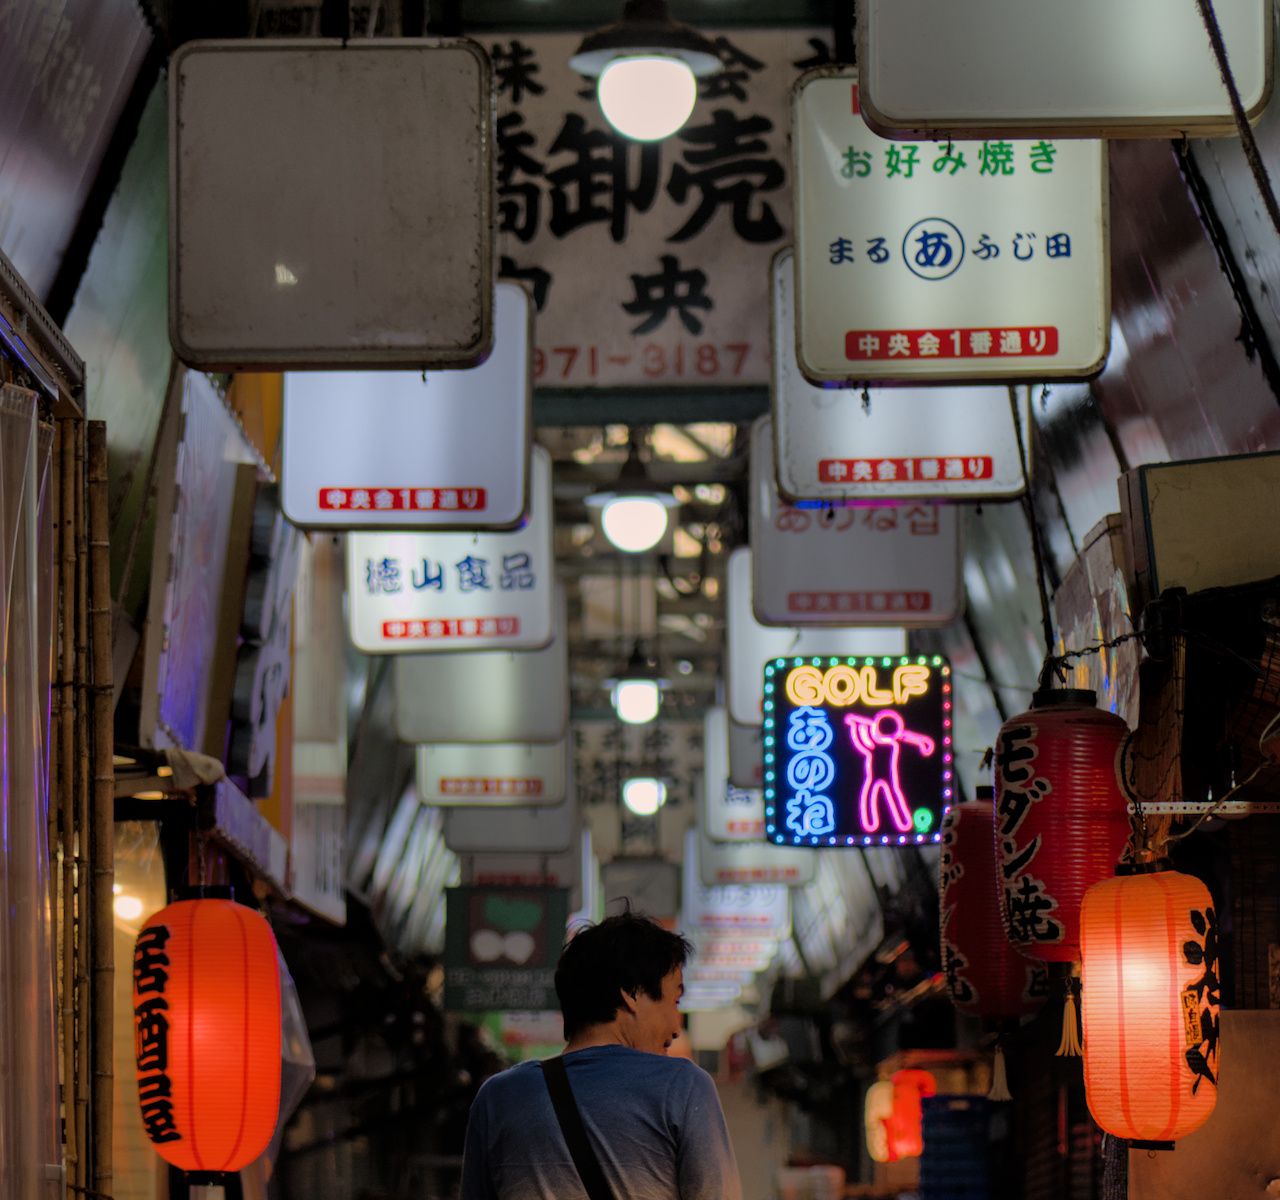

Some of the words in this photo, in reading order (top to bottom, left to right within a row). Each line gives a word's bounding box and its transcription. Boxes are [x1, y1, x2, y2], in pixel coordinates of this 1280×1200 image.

[839, 140, 1059, 179] お好み焼き
[858, 329, 1049, 357] 中央会1番通り
[828, 455, 986, 480] 中央会1番通り
[326, 488, 480, 509] 中央会1番通り
[366, 552, 536, 595] 徳山食品
[786, 664, 930, 706] GOLF
[997, 723, 1063, 943] モダン焼
